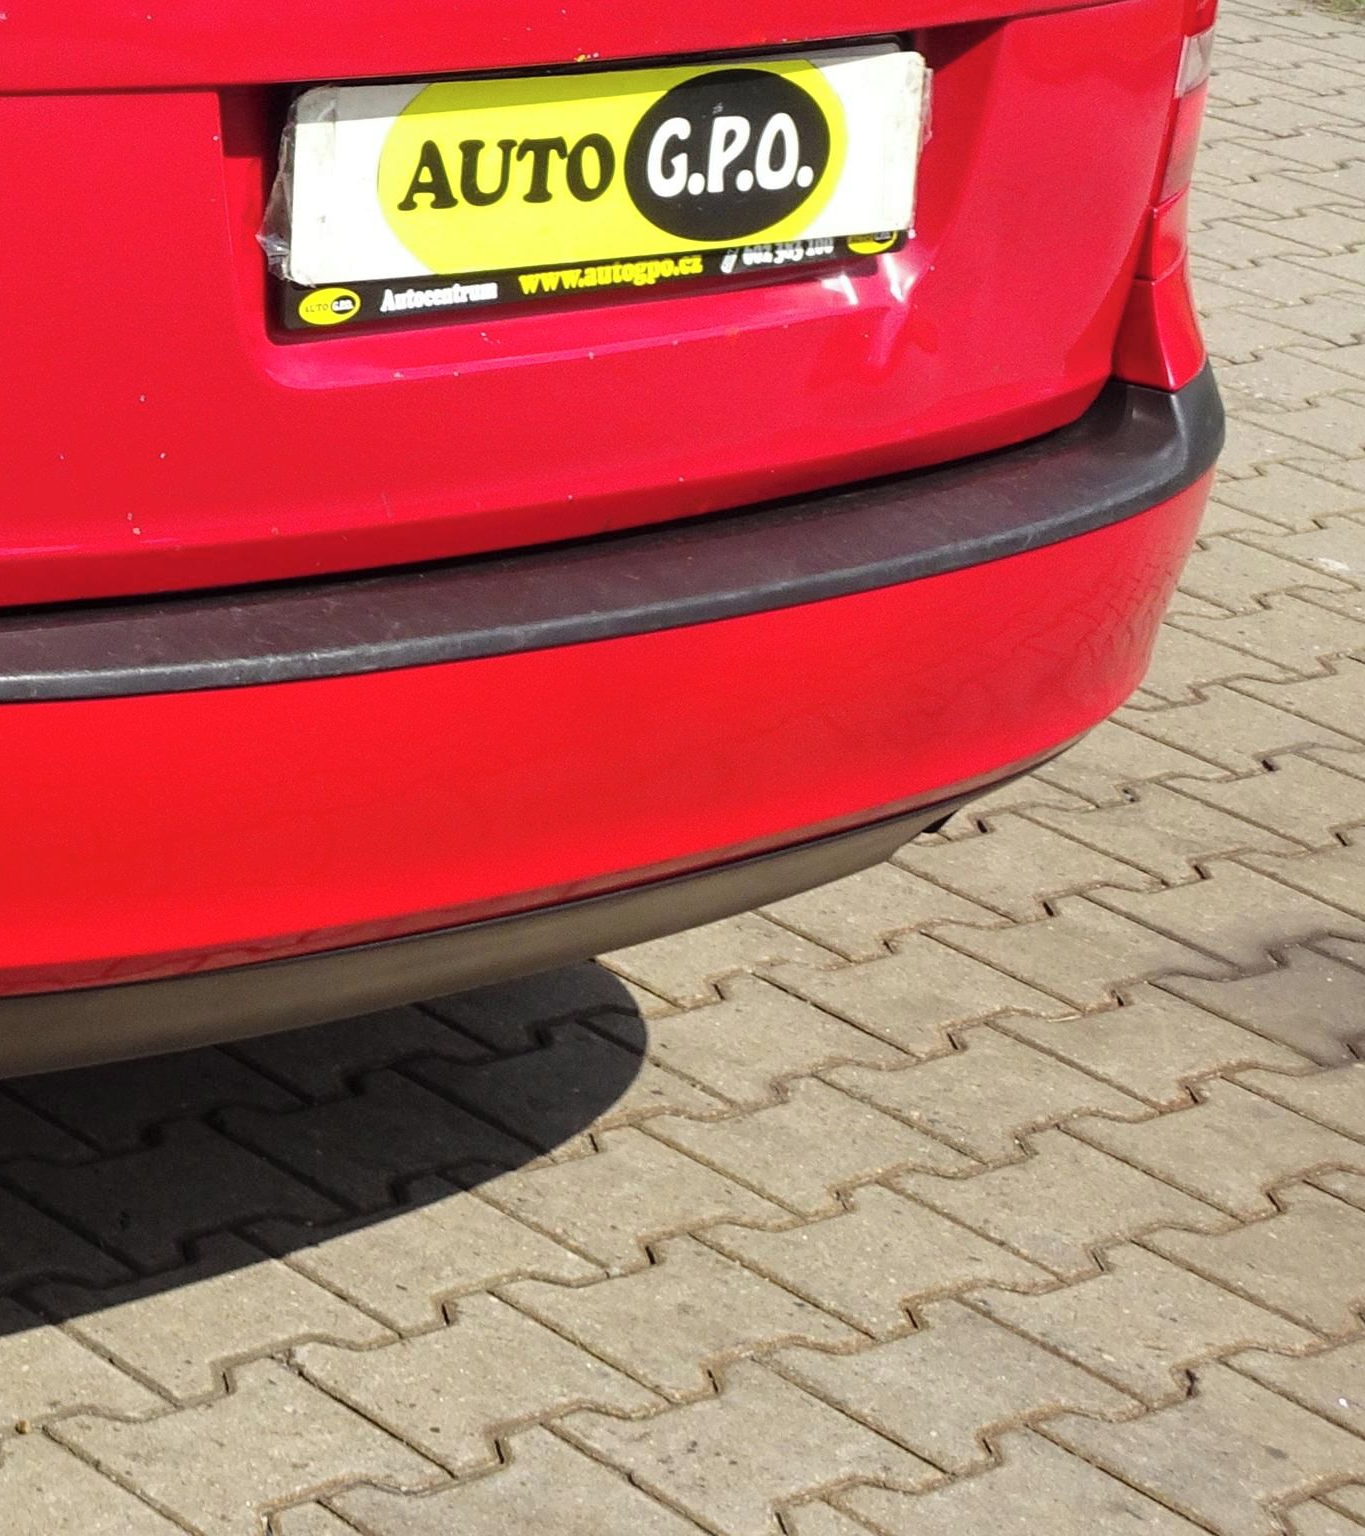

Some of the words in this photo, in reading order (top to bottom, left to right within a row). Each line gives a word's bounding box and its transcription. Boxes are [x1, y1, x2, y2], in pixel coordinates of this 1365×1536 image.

[397, 133, 616, 211] AUTO
[647, 112, 814, 198] G.P.O.
[518, 255, 704, 295] www.autogpo.cz
[379, 282, 499, 314] Autocentrum
